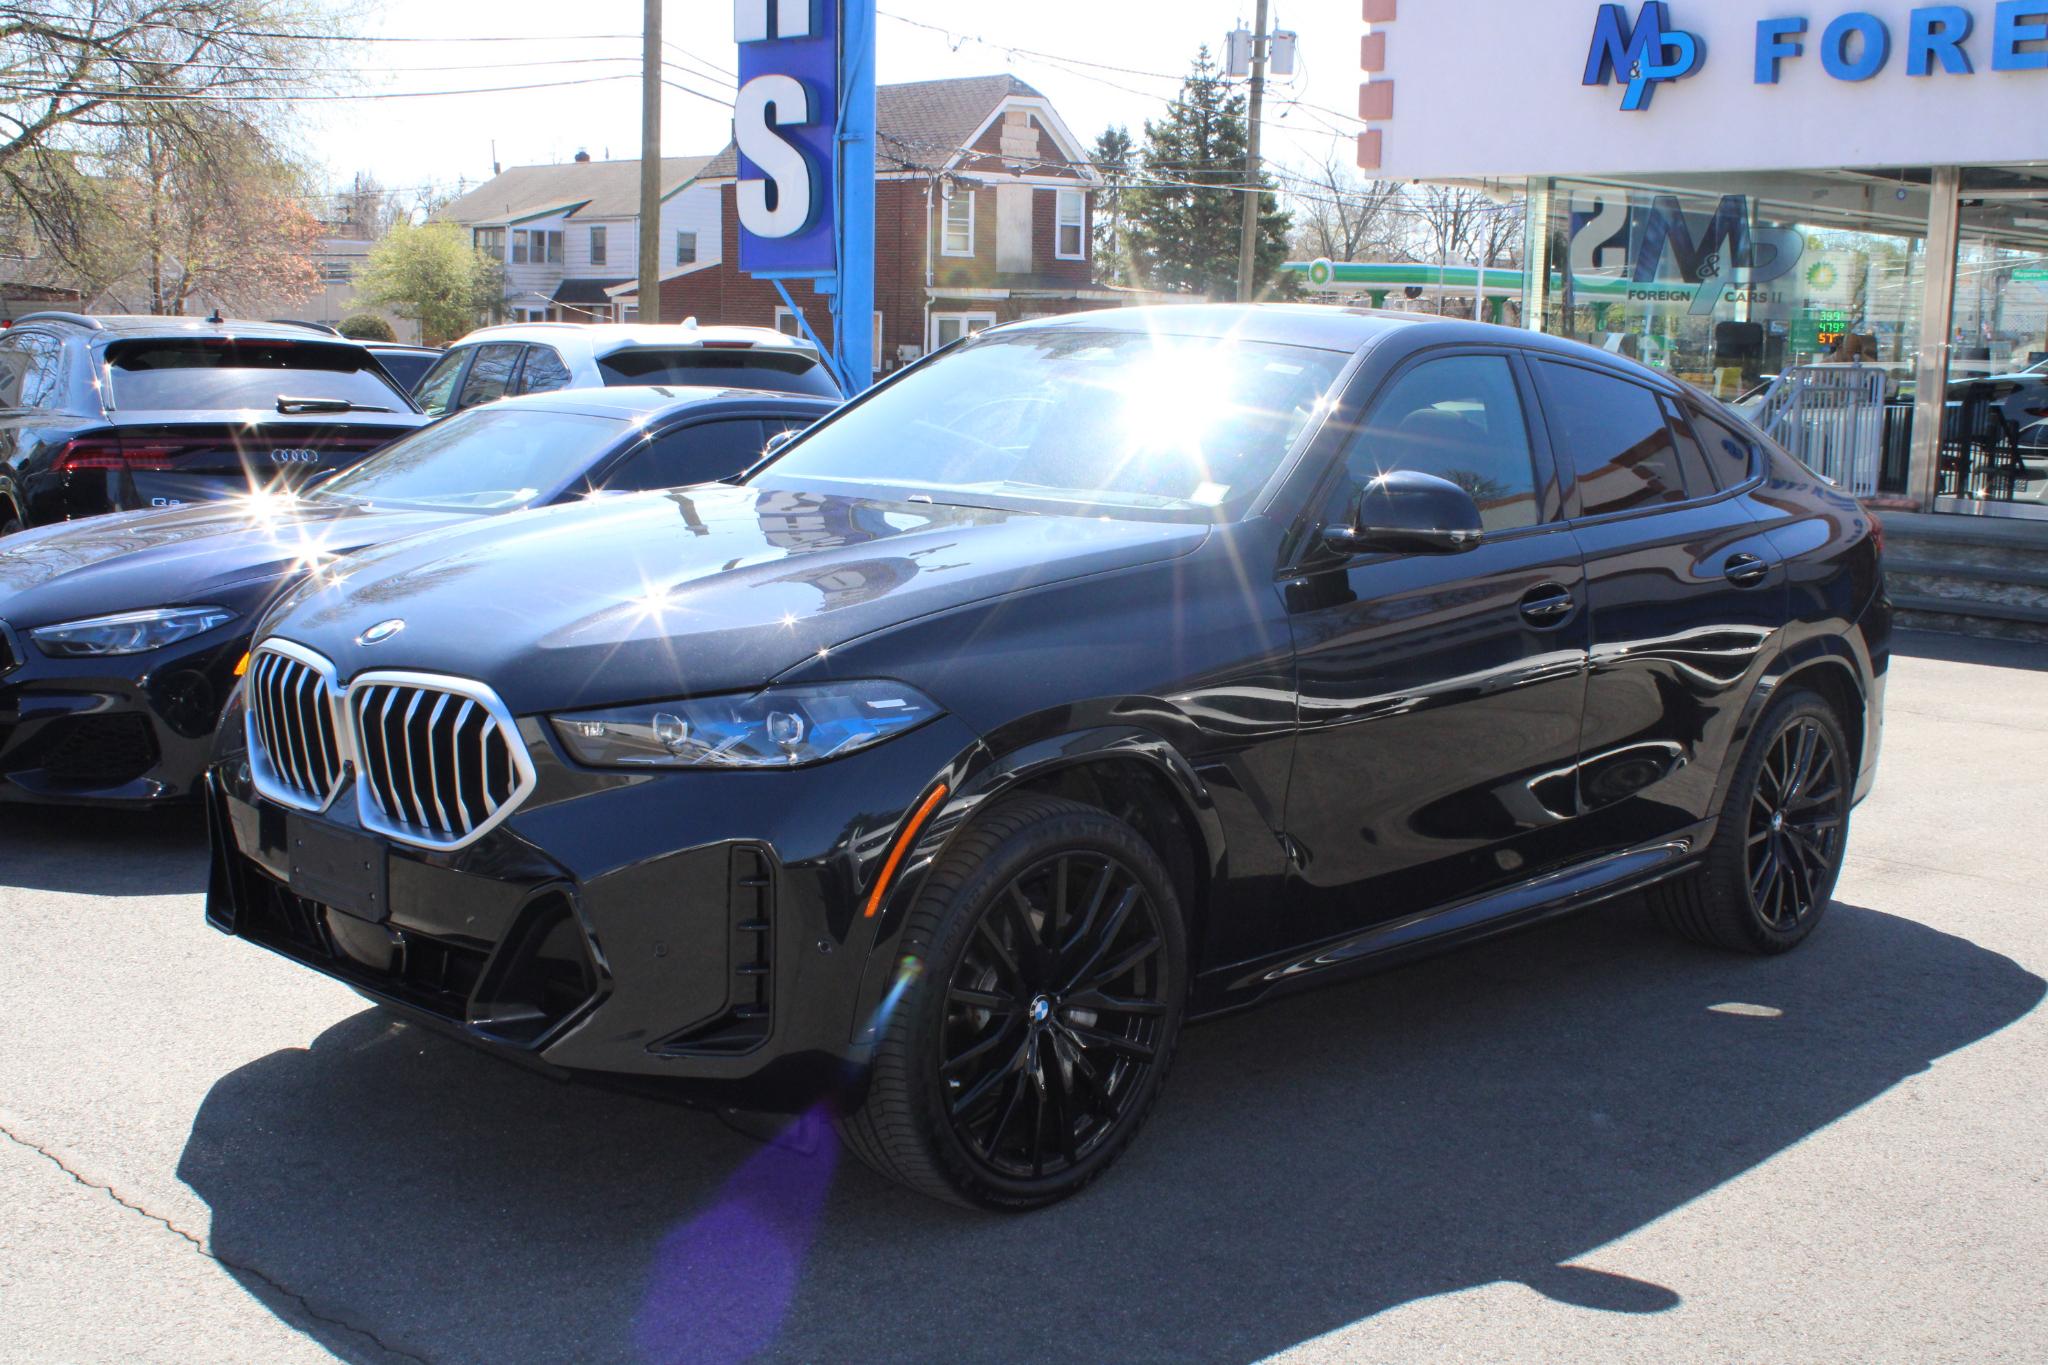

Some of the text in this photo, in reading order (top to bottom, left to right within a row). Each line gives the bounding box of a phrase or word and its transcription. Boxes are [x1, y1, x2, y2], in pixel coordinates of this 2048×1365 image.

[1754, 0, 2048, 84] FORE
[734, 0, 822, 239] S
[1628, 290, 1691, 301] FOREIGN
[1724, 291, 1768, 303] CARS
